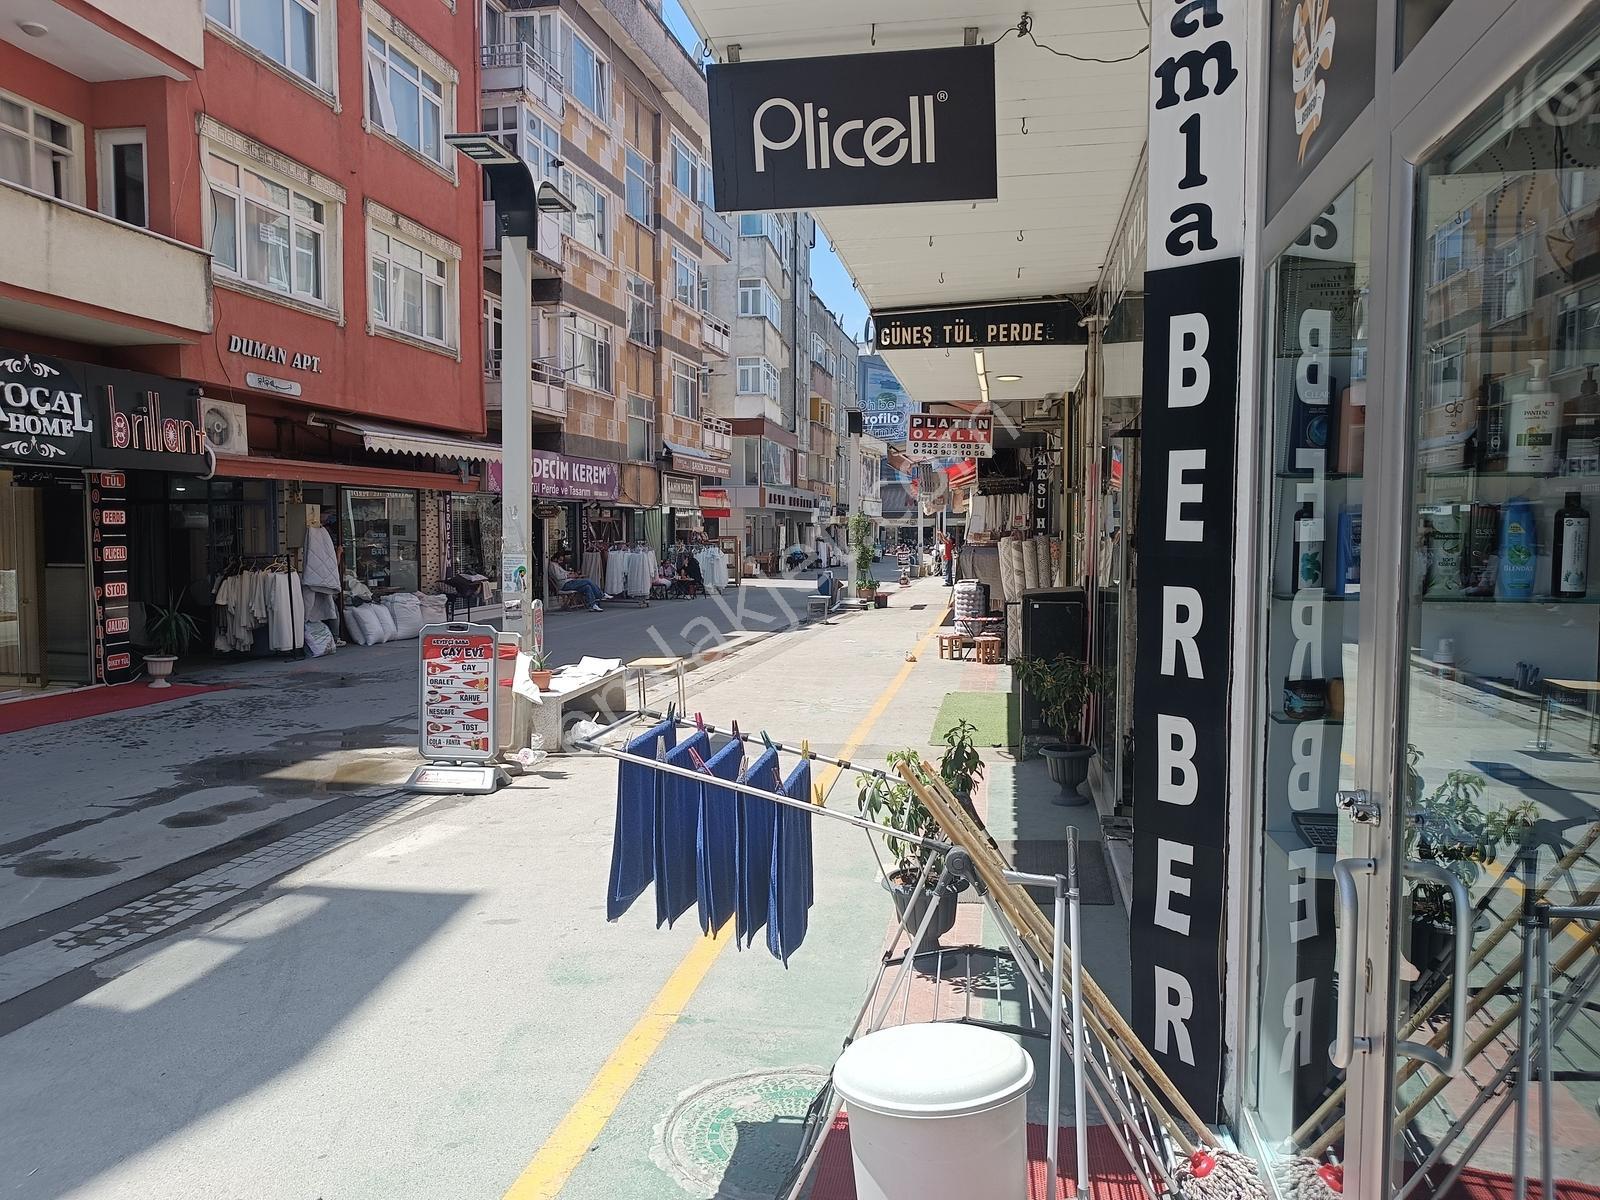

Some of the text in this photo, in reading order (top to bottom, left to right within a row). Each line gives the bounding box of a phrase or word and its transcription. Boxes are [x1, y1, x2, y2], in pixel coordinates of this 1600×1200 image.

[880, 318, 1044, 347] GÜNEŞ TÜL PERDE
[229, 334, 323, 374] DUMAN APT.
[8, 412, 75, 438] HOME
[104, 474, 122, 487] TÜL
[572, 462, 607, 486] KEREM
[541, 483, 560, 495] Perde
[569, 486, 591, 497] Tasarım
[104, 511, 125, 524] PERDE
[106, 583, 126, 597] STOR
[429, 678, 454, 686] ORALET
[1152, 311, 1213, 1068] BERBER
[459, 694, 481, 702] KAHVE
[428, 708, 455, 716] NESCAFE
[461, 723, 479, 731] TOST
[445, 739, 461, 747] FANTA
